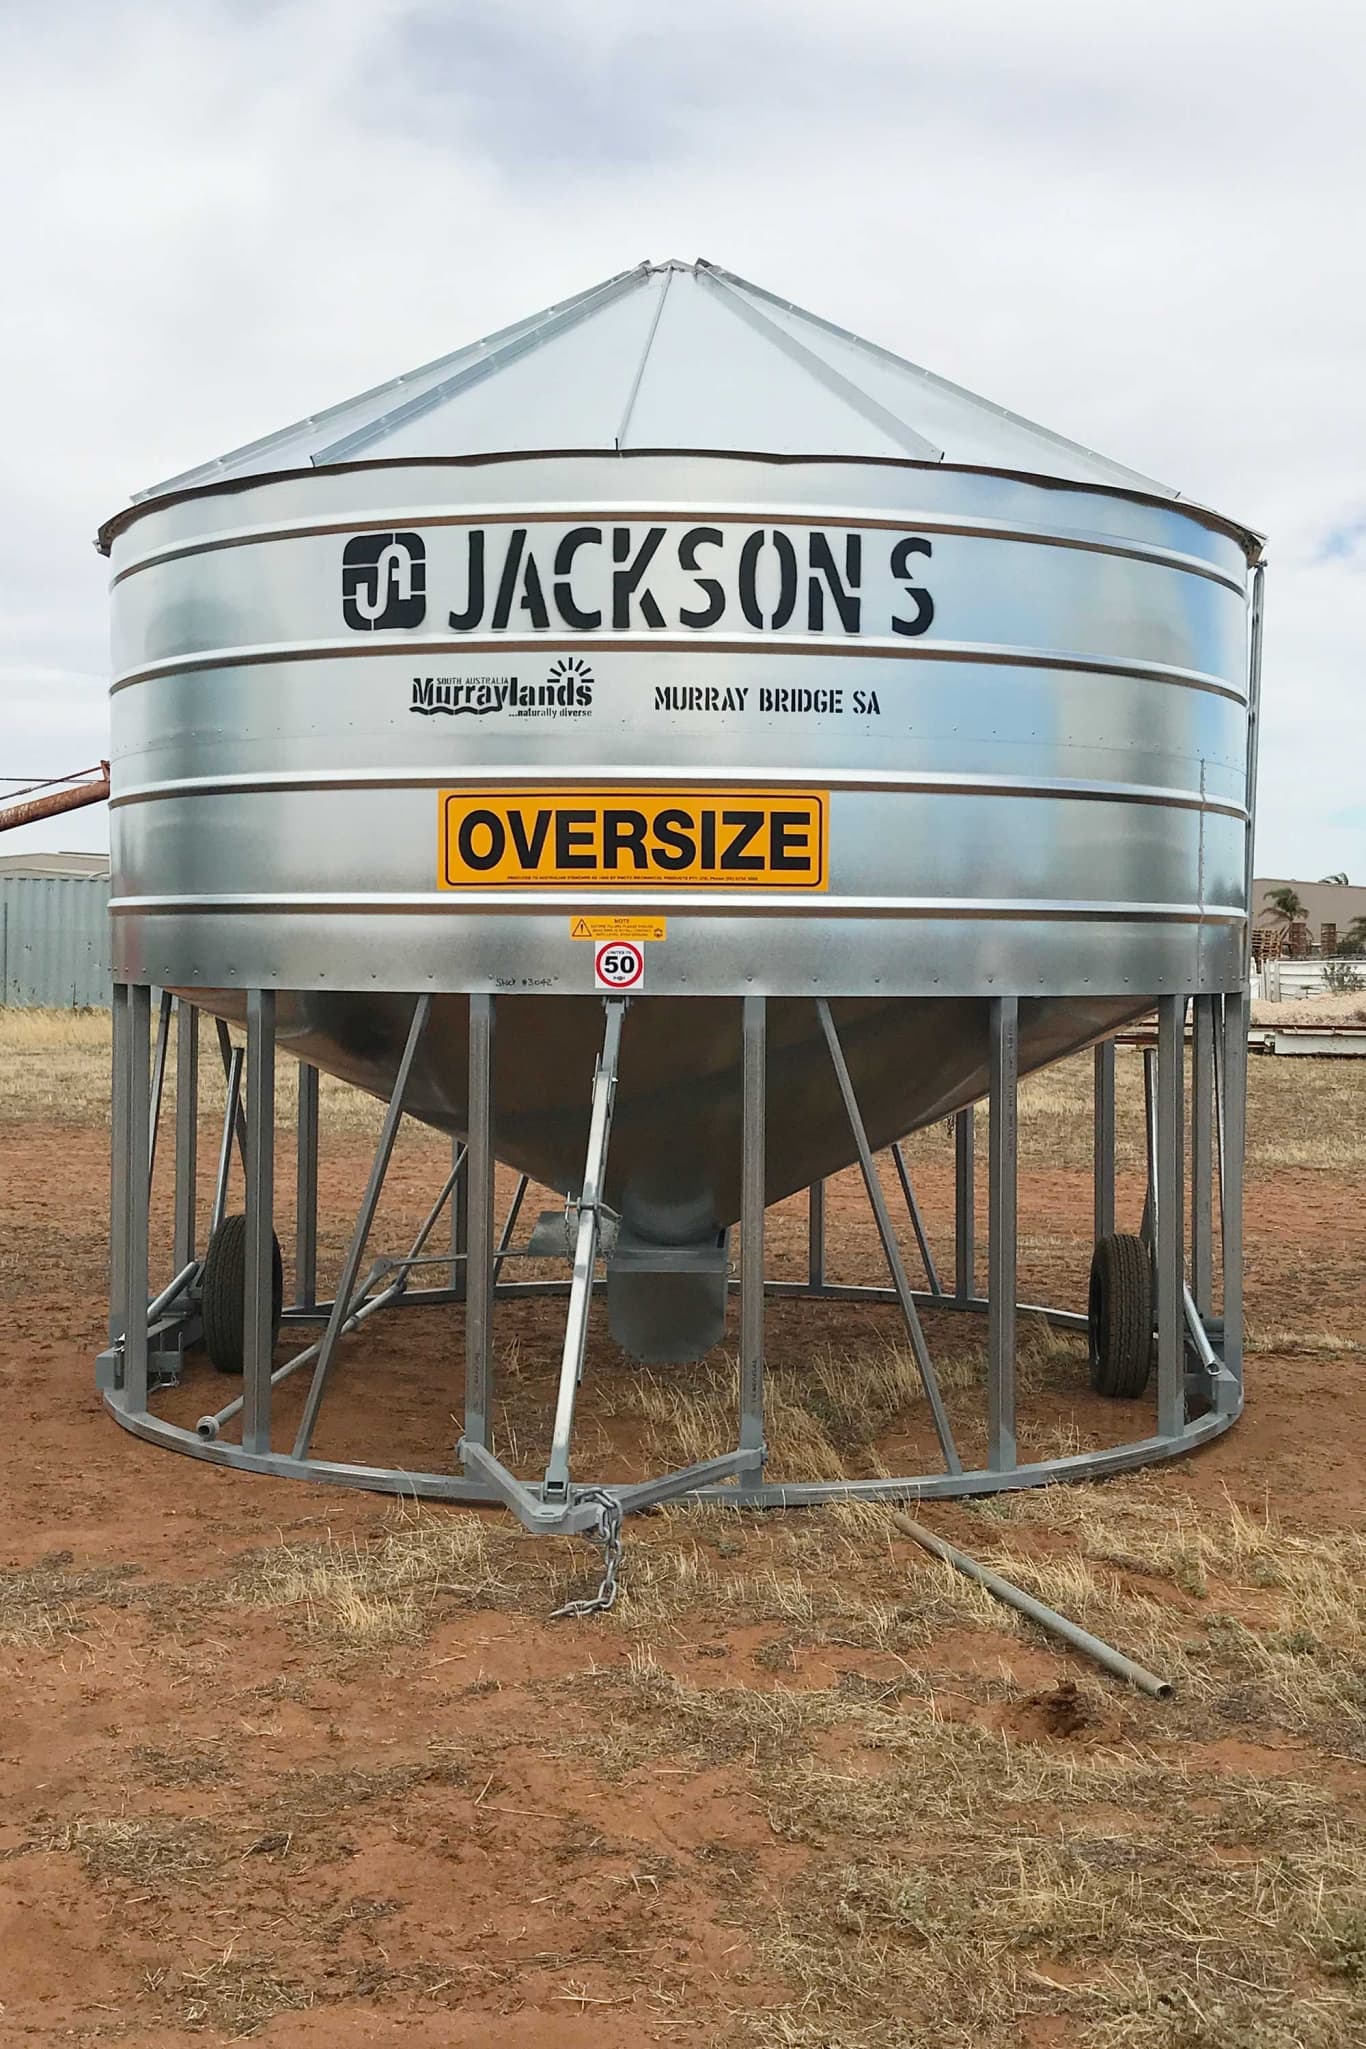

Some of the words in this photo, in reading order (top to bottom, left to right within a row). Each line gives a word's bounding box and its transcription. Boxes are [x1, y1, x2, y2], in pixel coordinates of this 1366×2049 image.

[465, 677, 509, 685] AUSTRALIA
[412, 677, 593, 711] Murraylands
[654, 686, 749, 711] MURRAY
[759, 688, 843, 713] BRIDGE
[852, 690, 881, 715] SA
[559, 708, 592, 717] diverse
[458, 809, 811, 871] OVERSIZE
[604, 956, 635, 974] 50
